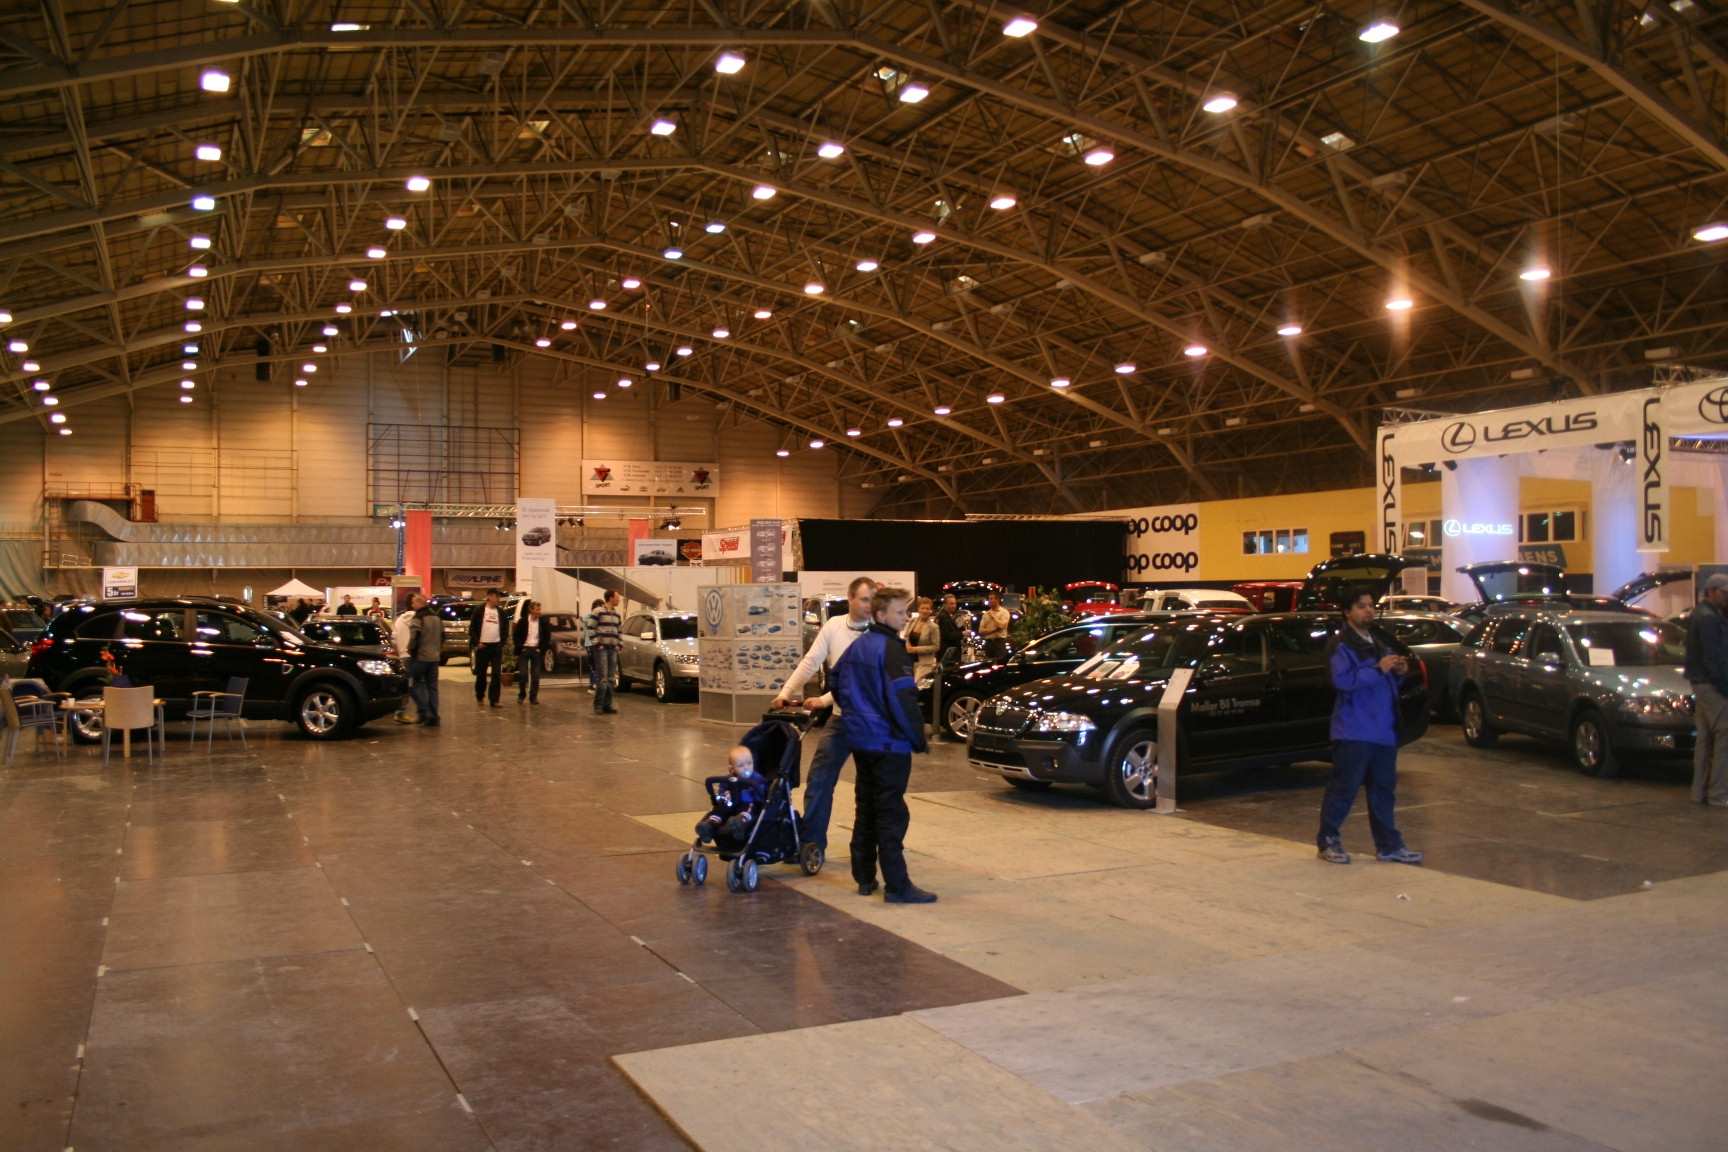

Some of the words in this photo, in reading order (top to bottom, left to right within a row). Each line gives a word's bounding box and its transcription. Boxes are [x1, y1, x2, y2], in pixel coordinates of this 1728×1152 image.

[1484, 411, 1598, 442] LEXUS
[1644, 398, 1662, 544] LEXUS
[1382, 434, 1397, 554] LEXUS
[1151, 513, 1198, 535] coop
[1462, 523, 1513, 535] LEXUS
[1152, 552, 1199, 573] coop
